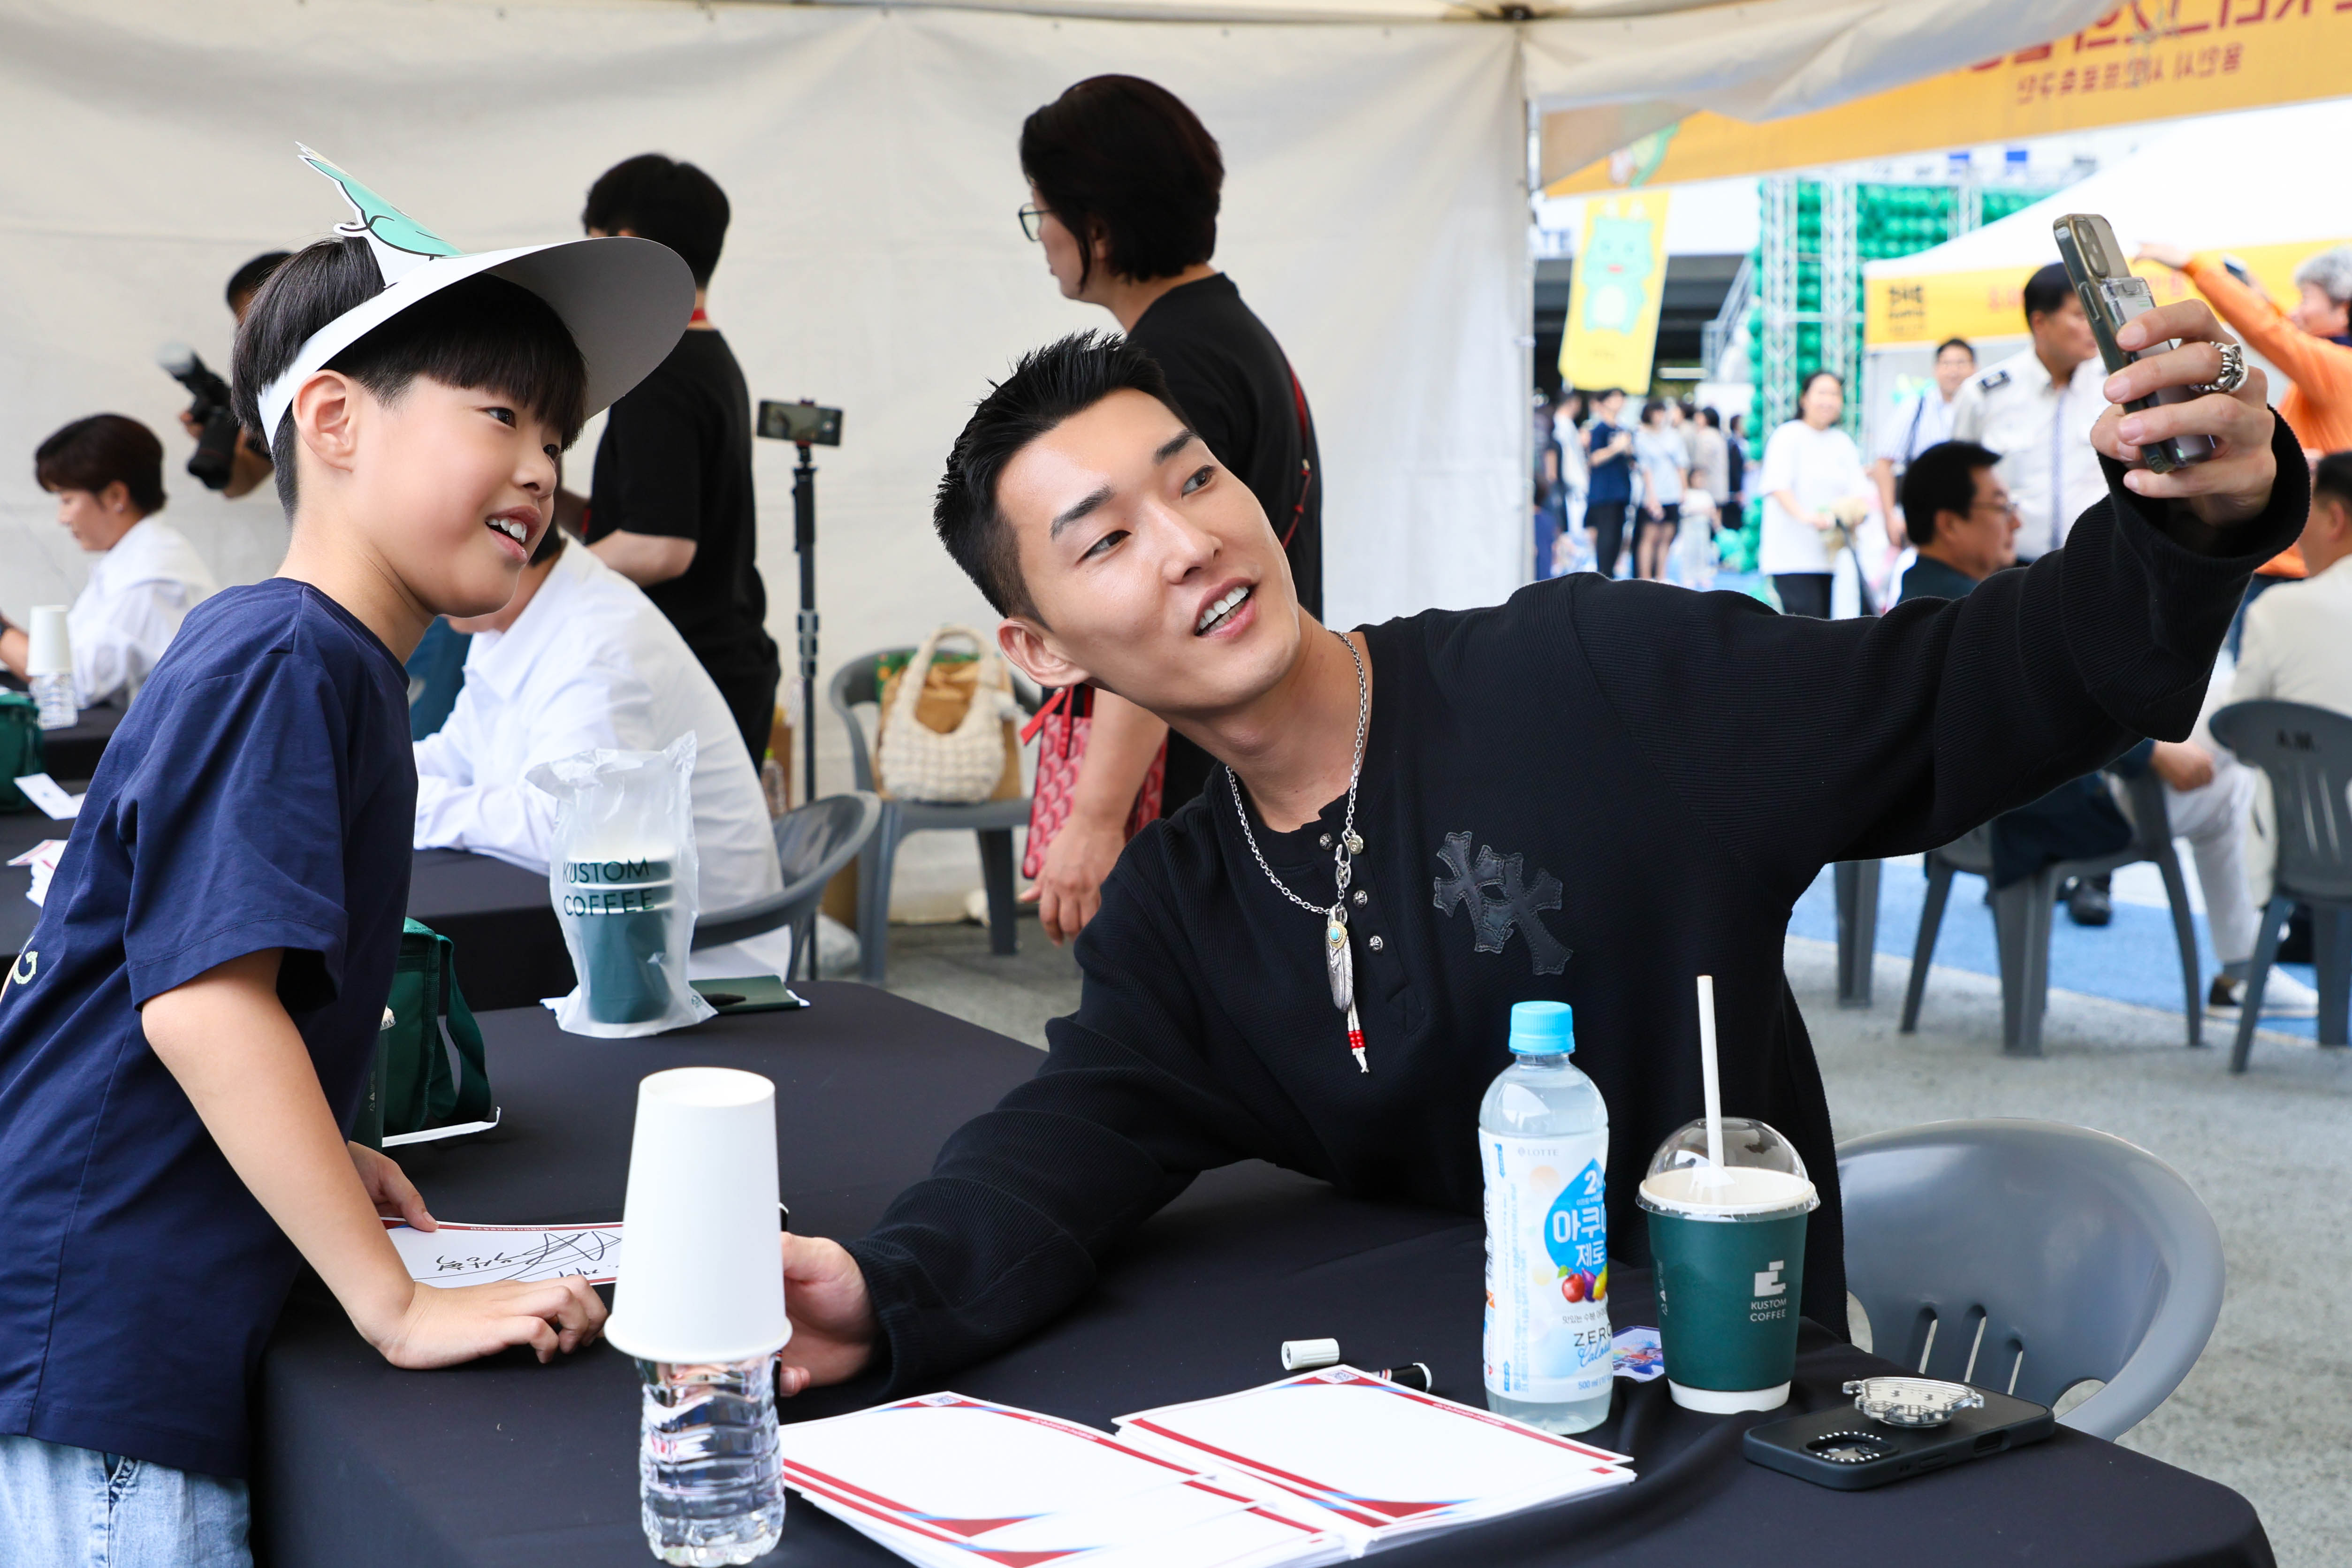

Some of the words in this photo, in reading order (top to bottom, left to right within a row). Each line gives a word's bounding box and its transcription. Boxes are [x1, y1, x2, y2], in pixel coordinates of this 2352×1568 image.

[563, 856, 649, 883] KUSTOM
[563, 889, 655, 916] COFFEE
[1527, 1148, 1560, 1157] LOTTE
[1575, 1240, 1605, 1267] 제로
[1751, 1298, 1787, 1310] KUSTOM
[1750, 1309, 1786, 1322] COFFEE
[1578, 1380, 1591, 1390] 500
